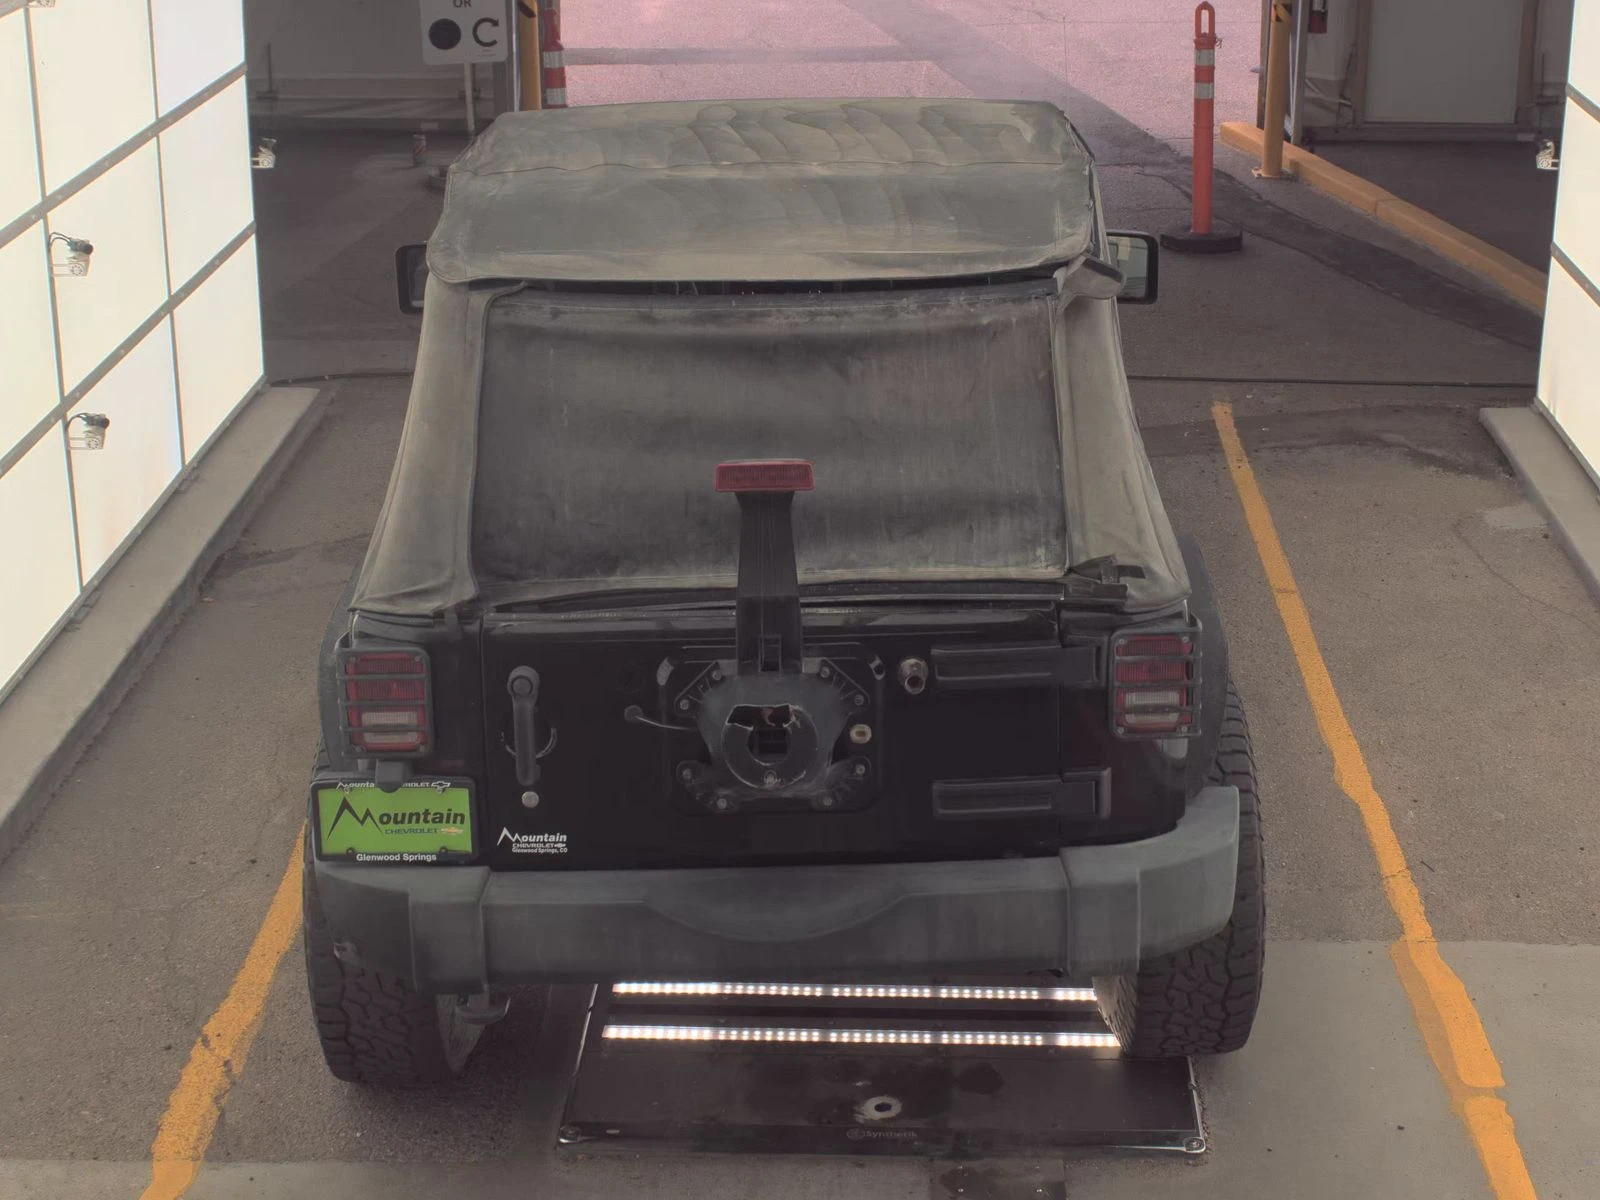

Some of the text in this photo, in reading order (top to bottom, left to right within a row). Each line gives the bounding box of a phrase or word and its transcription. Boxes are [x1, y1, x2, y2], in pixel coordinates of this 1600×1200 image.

[453, 0, 472, 8] OR
[336, 781, 375, 790] Mounta
[326, 796, 466, 841] Mountain
[384, 827, 438, 836] CHEVROLET
[496, 826, 567, 846] Mountain
[356, 853, 437, 864] Glenwood Springs
